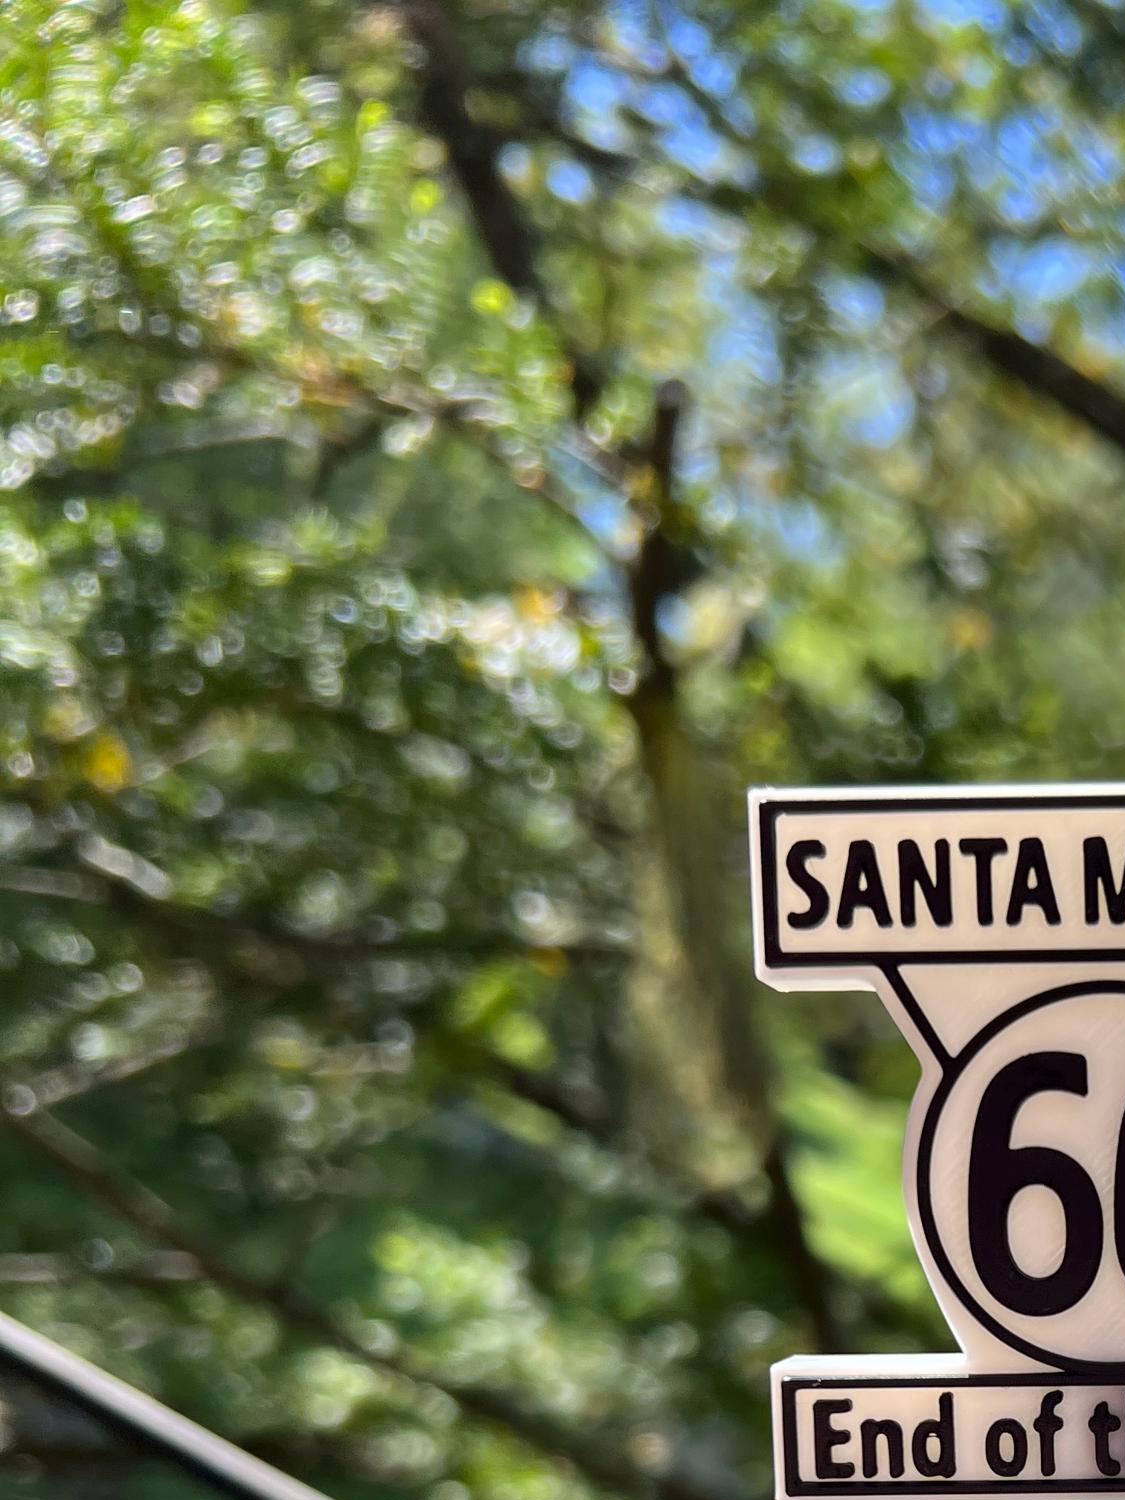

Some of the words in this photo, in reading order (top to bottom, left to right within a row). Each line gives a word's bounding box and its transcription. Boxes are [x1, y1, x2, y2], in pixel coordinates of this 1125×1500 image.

[785, 837, 1061, 929] SANTA
[812, 1391, 957, 1479] End
[984, 1390, 1064, 1477] of
